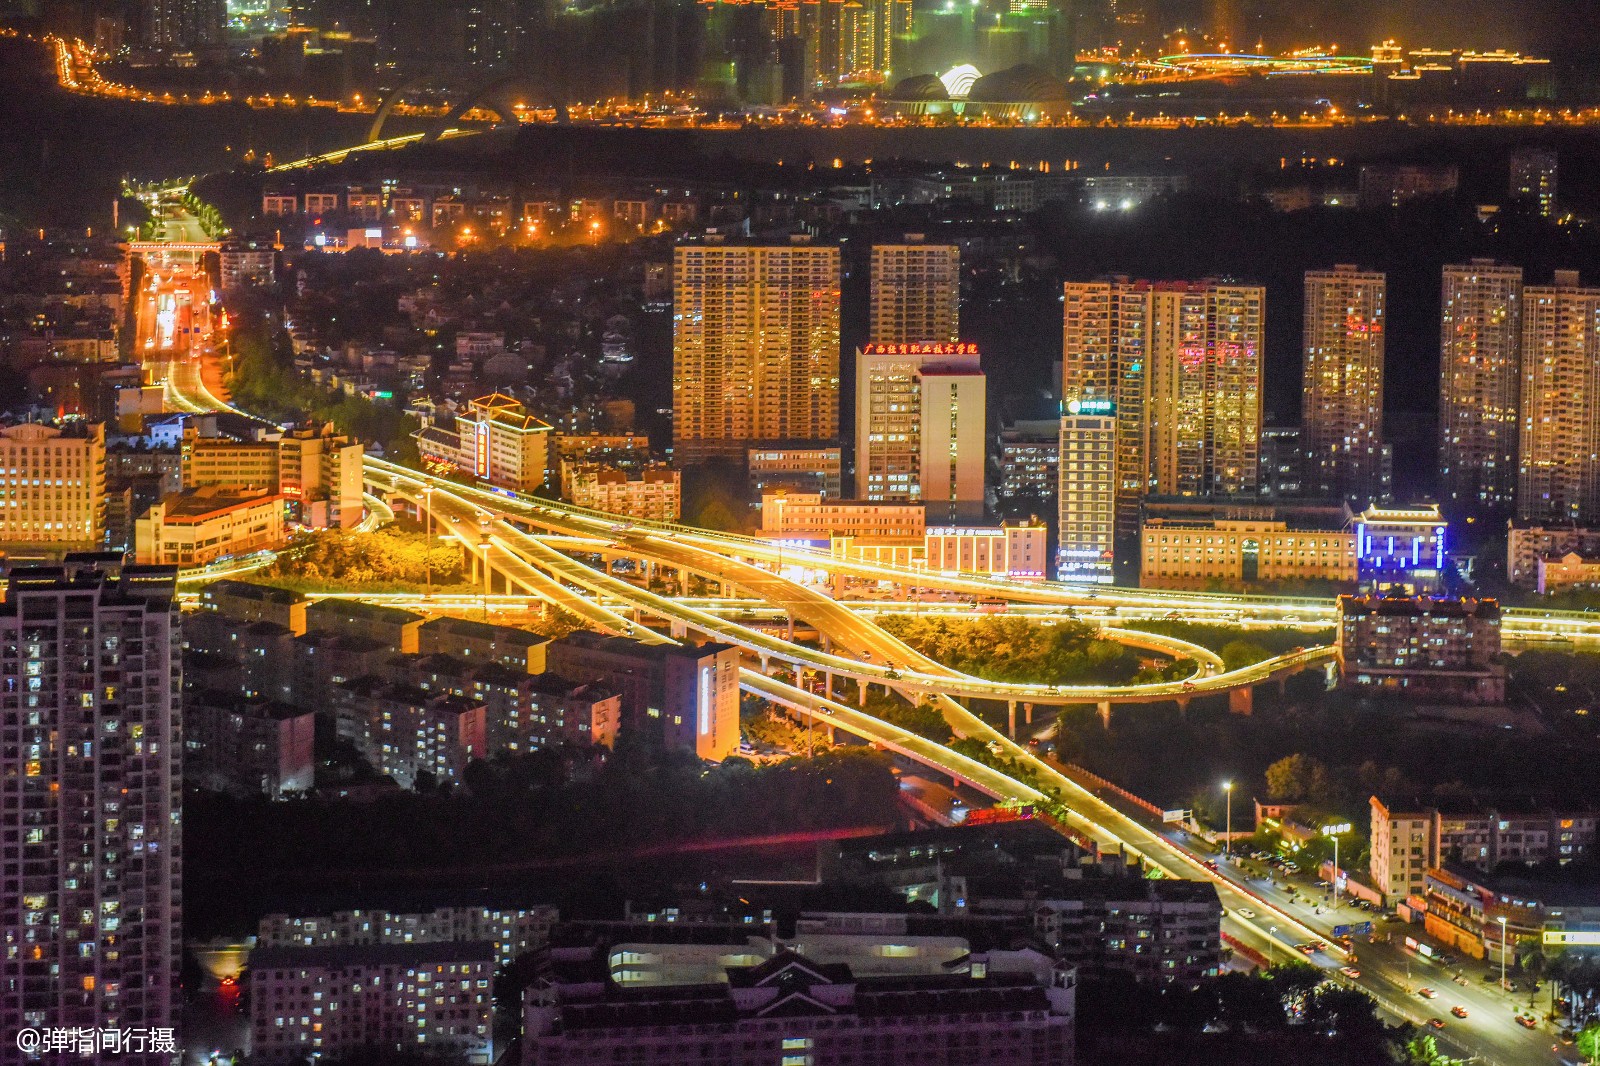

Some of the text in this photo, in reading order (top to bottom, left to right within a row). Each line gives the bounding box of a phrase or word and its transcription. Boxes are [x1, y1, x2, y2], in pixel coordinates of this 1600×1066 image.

[863, 343, 978, 355] 广西经贸职业技术学院
